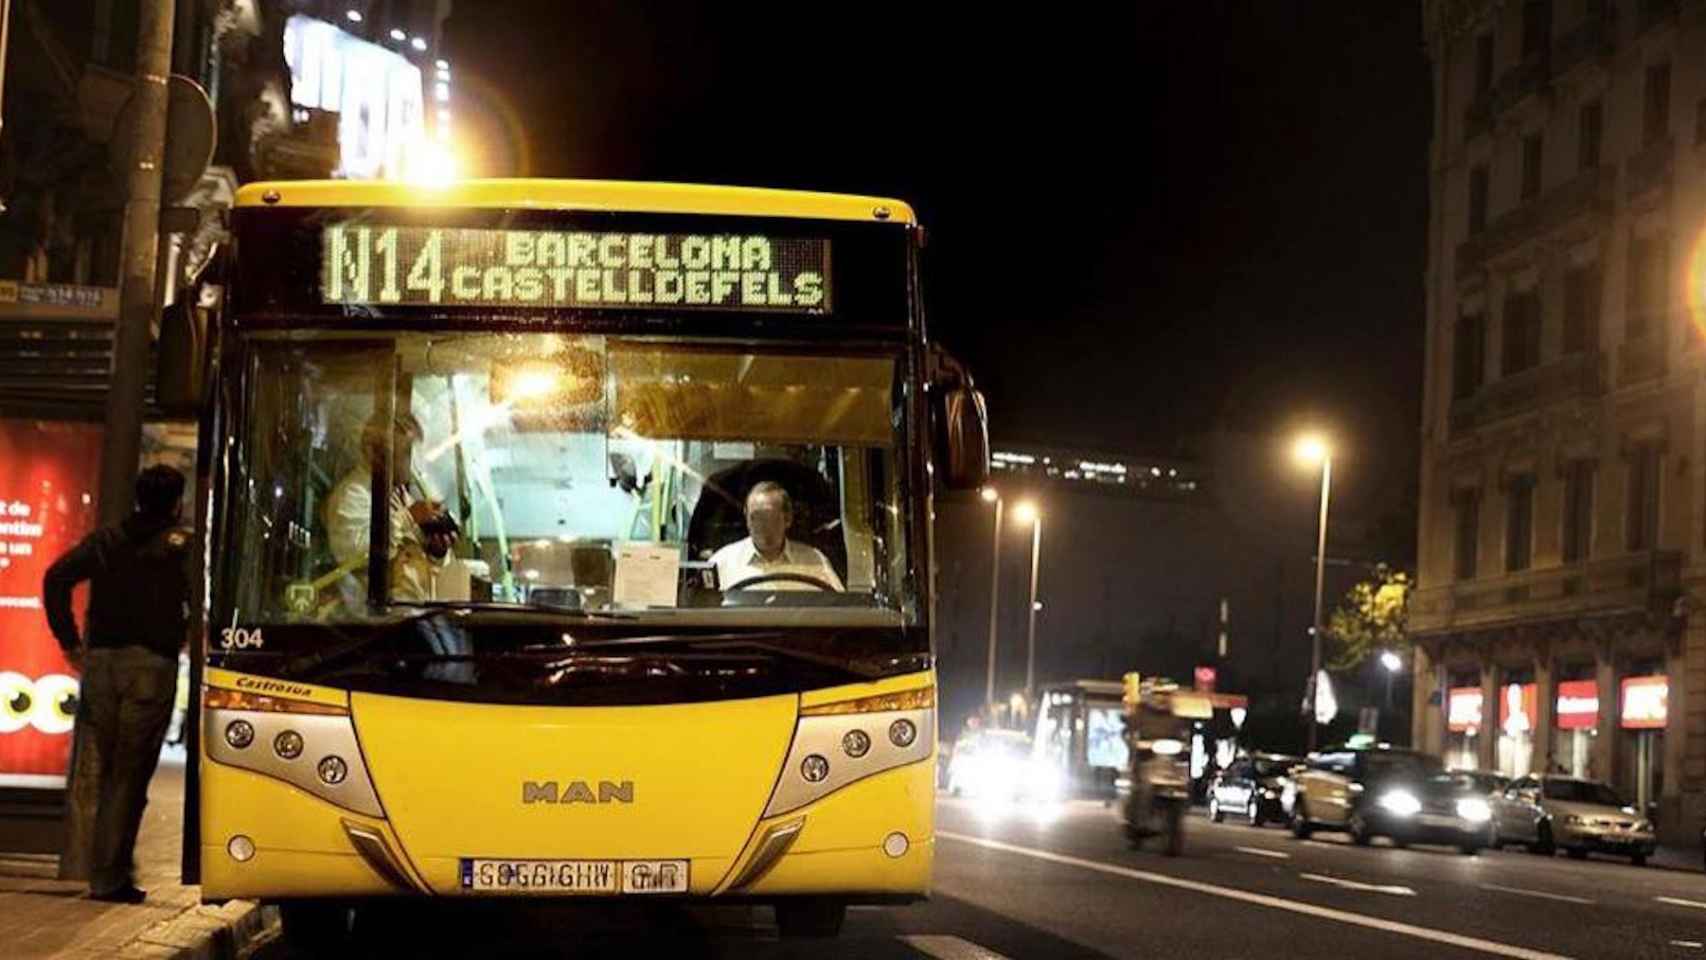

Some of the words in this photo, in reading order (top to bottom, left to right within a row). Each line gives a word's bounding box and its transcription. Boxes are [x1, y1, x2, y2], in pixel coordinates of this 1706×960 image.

[326, 227, 446, 303] N14
[452, 265, 825, 305] CASTELLDEFELS
[221, 627, 264, 648] 304
[236, 676, 312, 697] Castrosua
[522, 780, 635, 804] MAN
